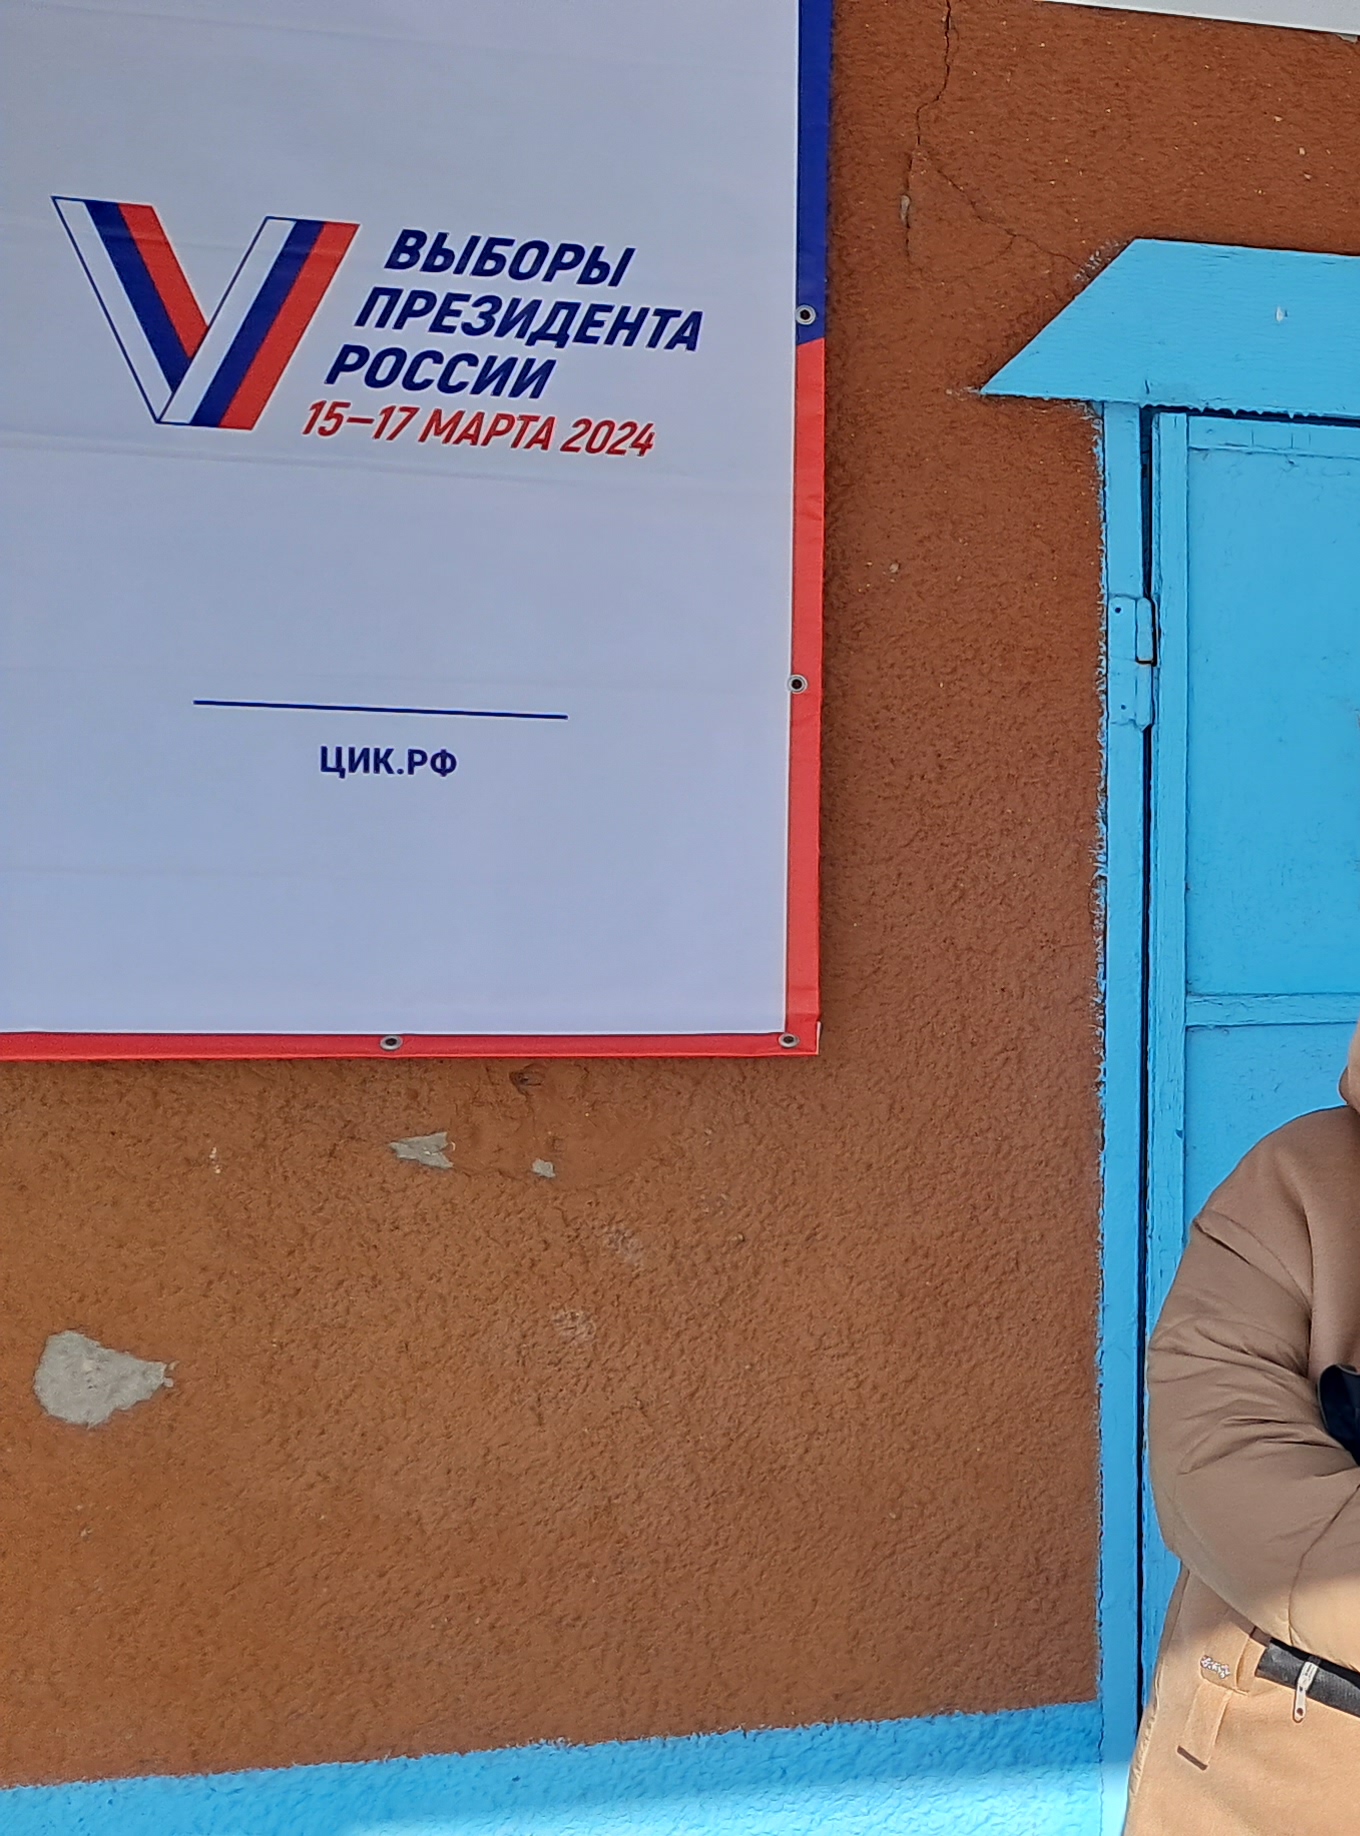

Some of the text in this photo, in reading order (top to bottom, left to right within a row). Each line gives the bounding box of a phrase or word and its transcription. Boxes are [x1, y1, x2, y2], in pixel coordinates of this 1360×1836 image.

[384, 229, 636, 288] ВЫБОРЫ
[354, 286, 704, 352] ПРЕЗИДЕНТА
[325, 343, 557, 399] РОССИИ
[418, 409, 556, 451] МАРТА
[560, 418, 655, 456] 2024
[320, 745, 458, 778] ЦИК.РФ
